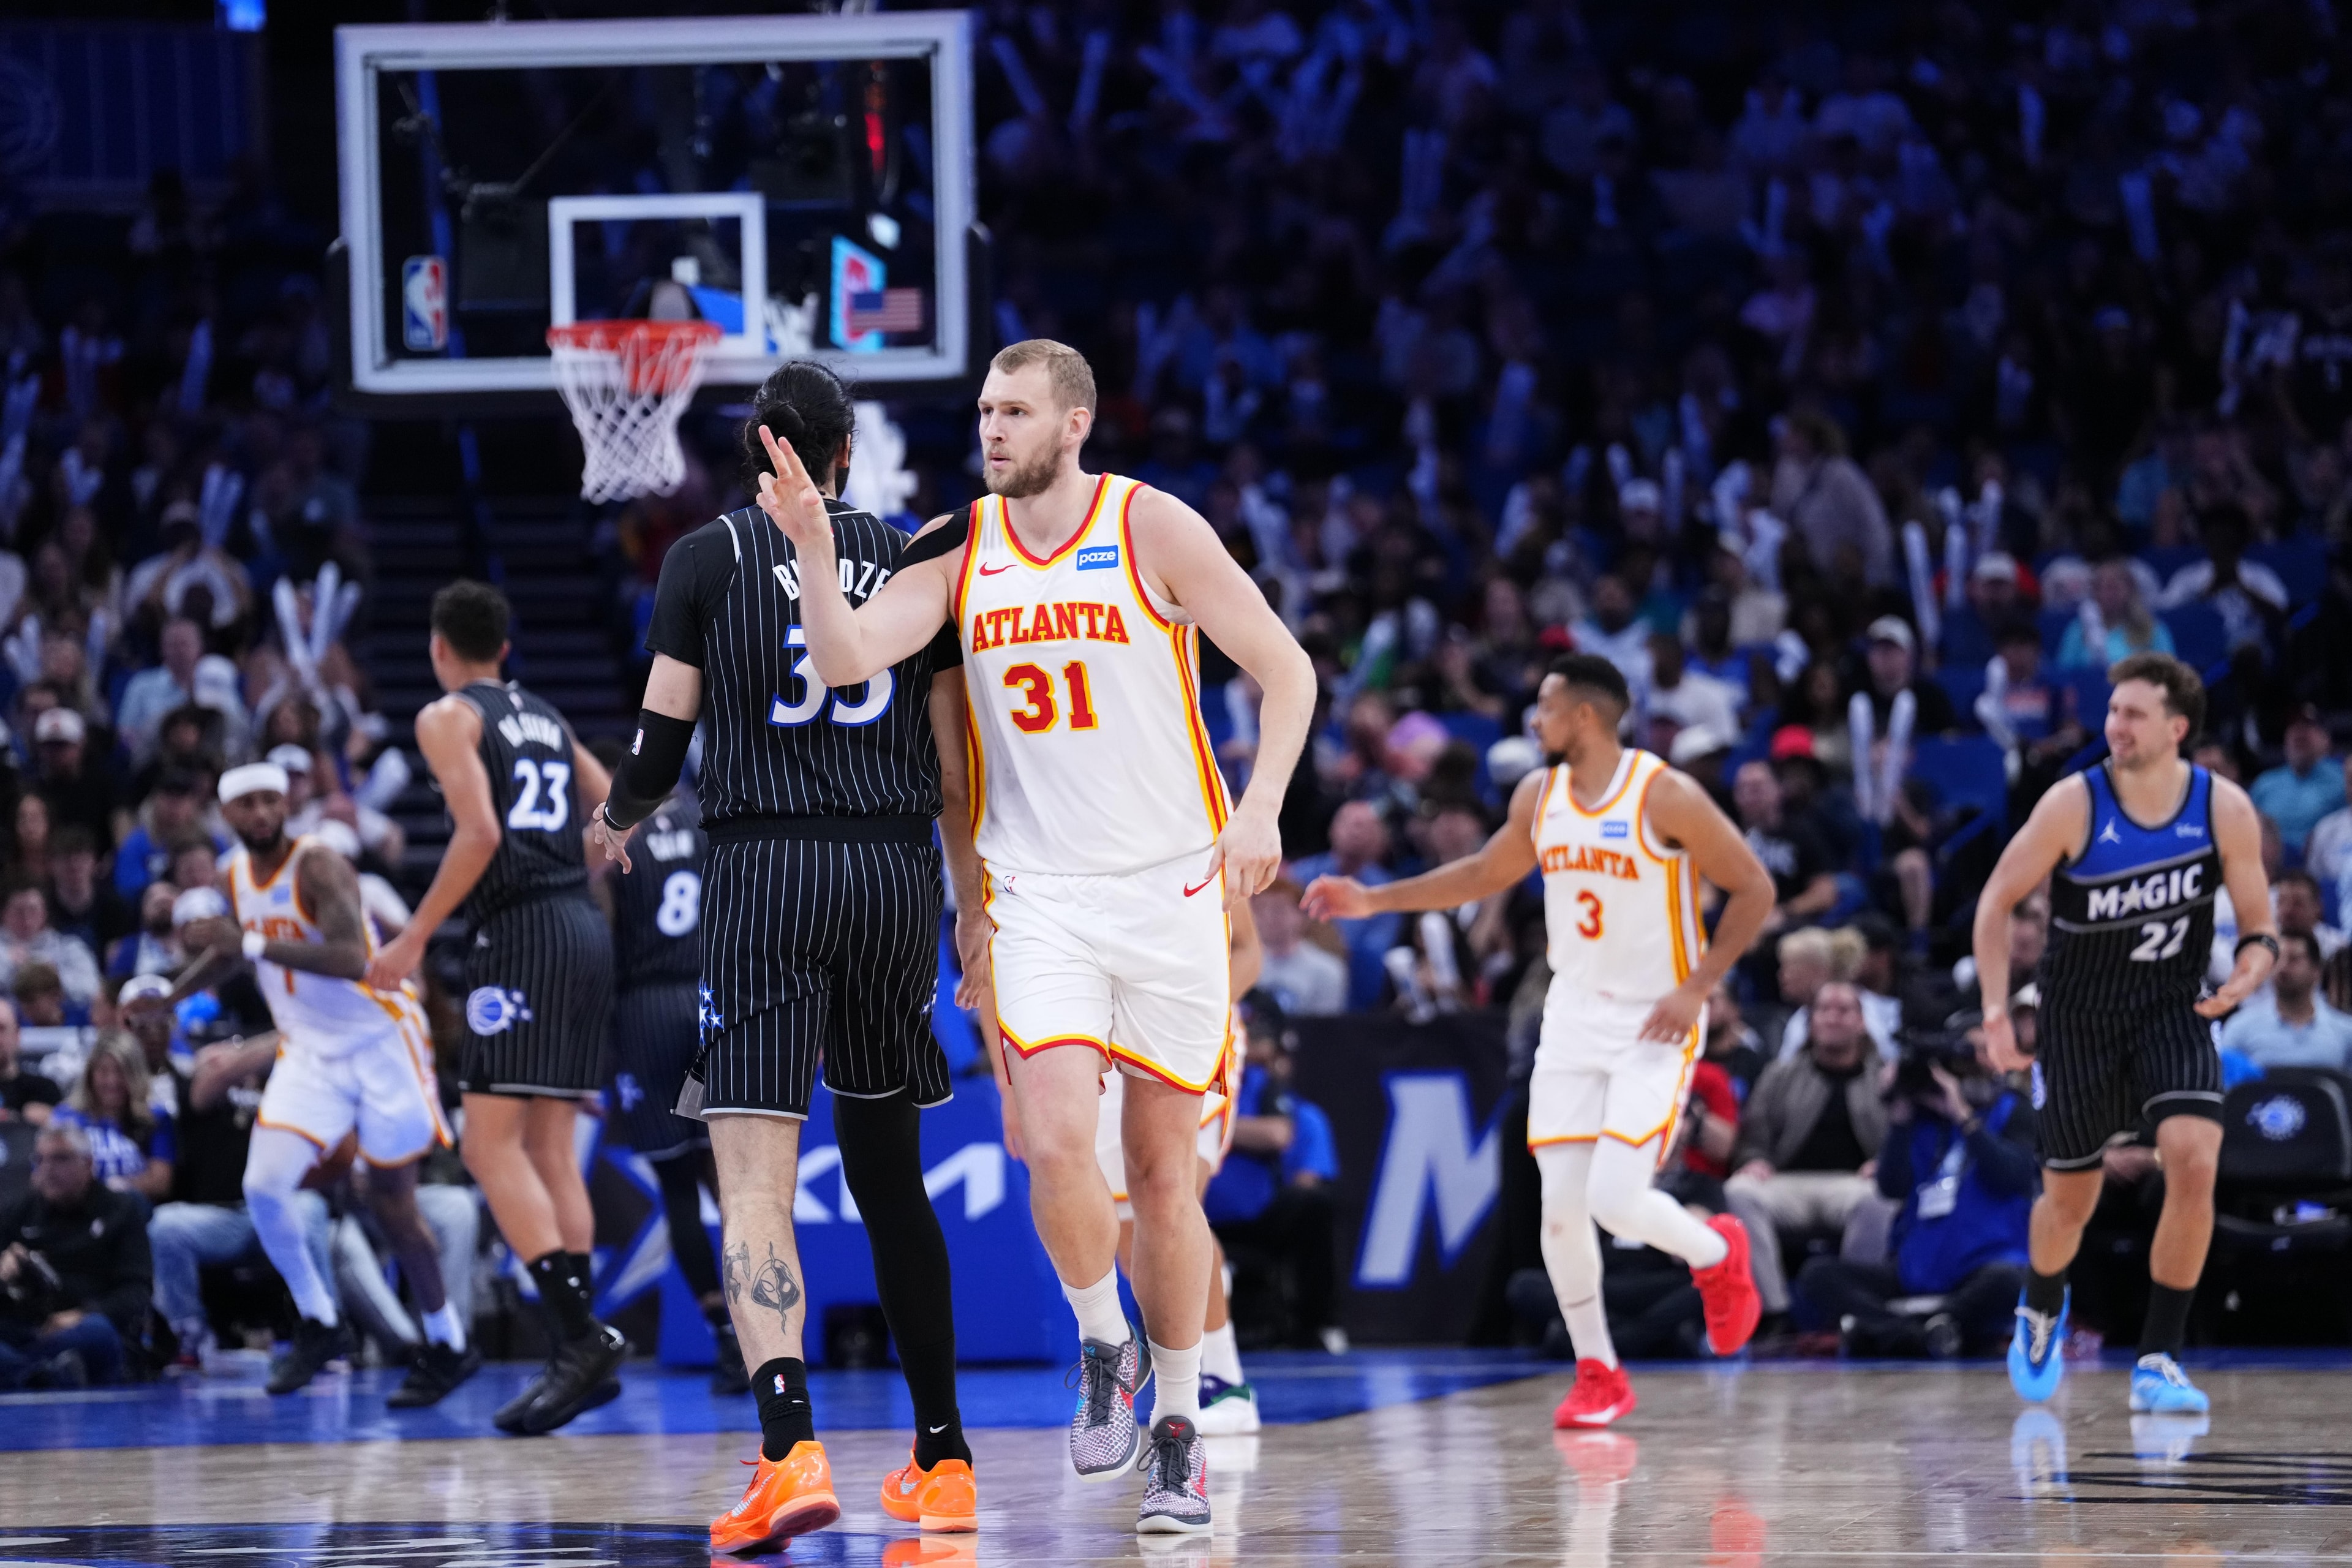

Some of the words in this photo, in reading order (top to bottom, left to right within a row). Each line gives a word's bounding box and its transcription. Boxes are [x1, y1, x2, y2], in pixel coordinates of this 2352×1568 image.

[772, 559, 892, 601] BDZE
[1079, 551, 1116, 566] paze
[971, 601, 1130, 655] ATLANTA
[1003, 660, 1099, 733] 31
[508, 758, 571, 832] 23
[1540, 843, 1639, 881] ATLANTA
[656, 870, 701, 937] 8
[1575, 888, 1604, 941] 3
[2129, 915, 2191, 962] 22
